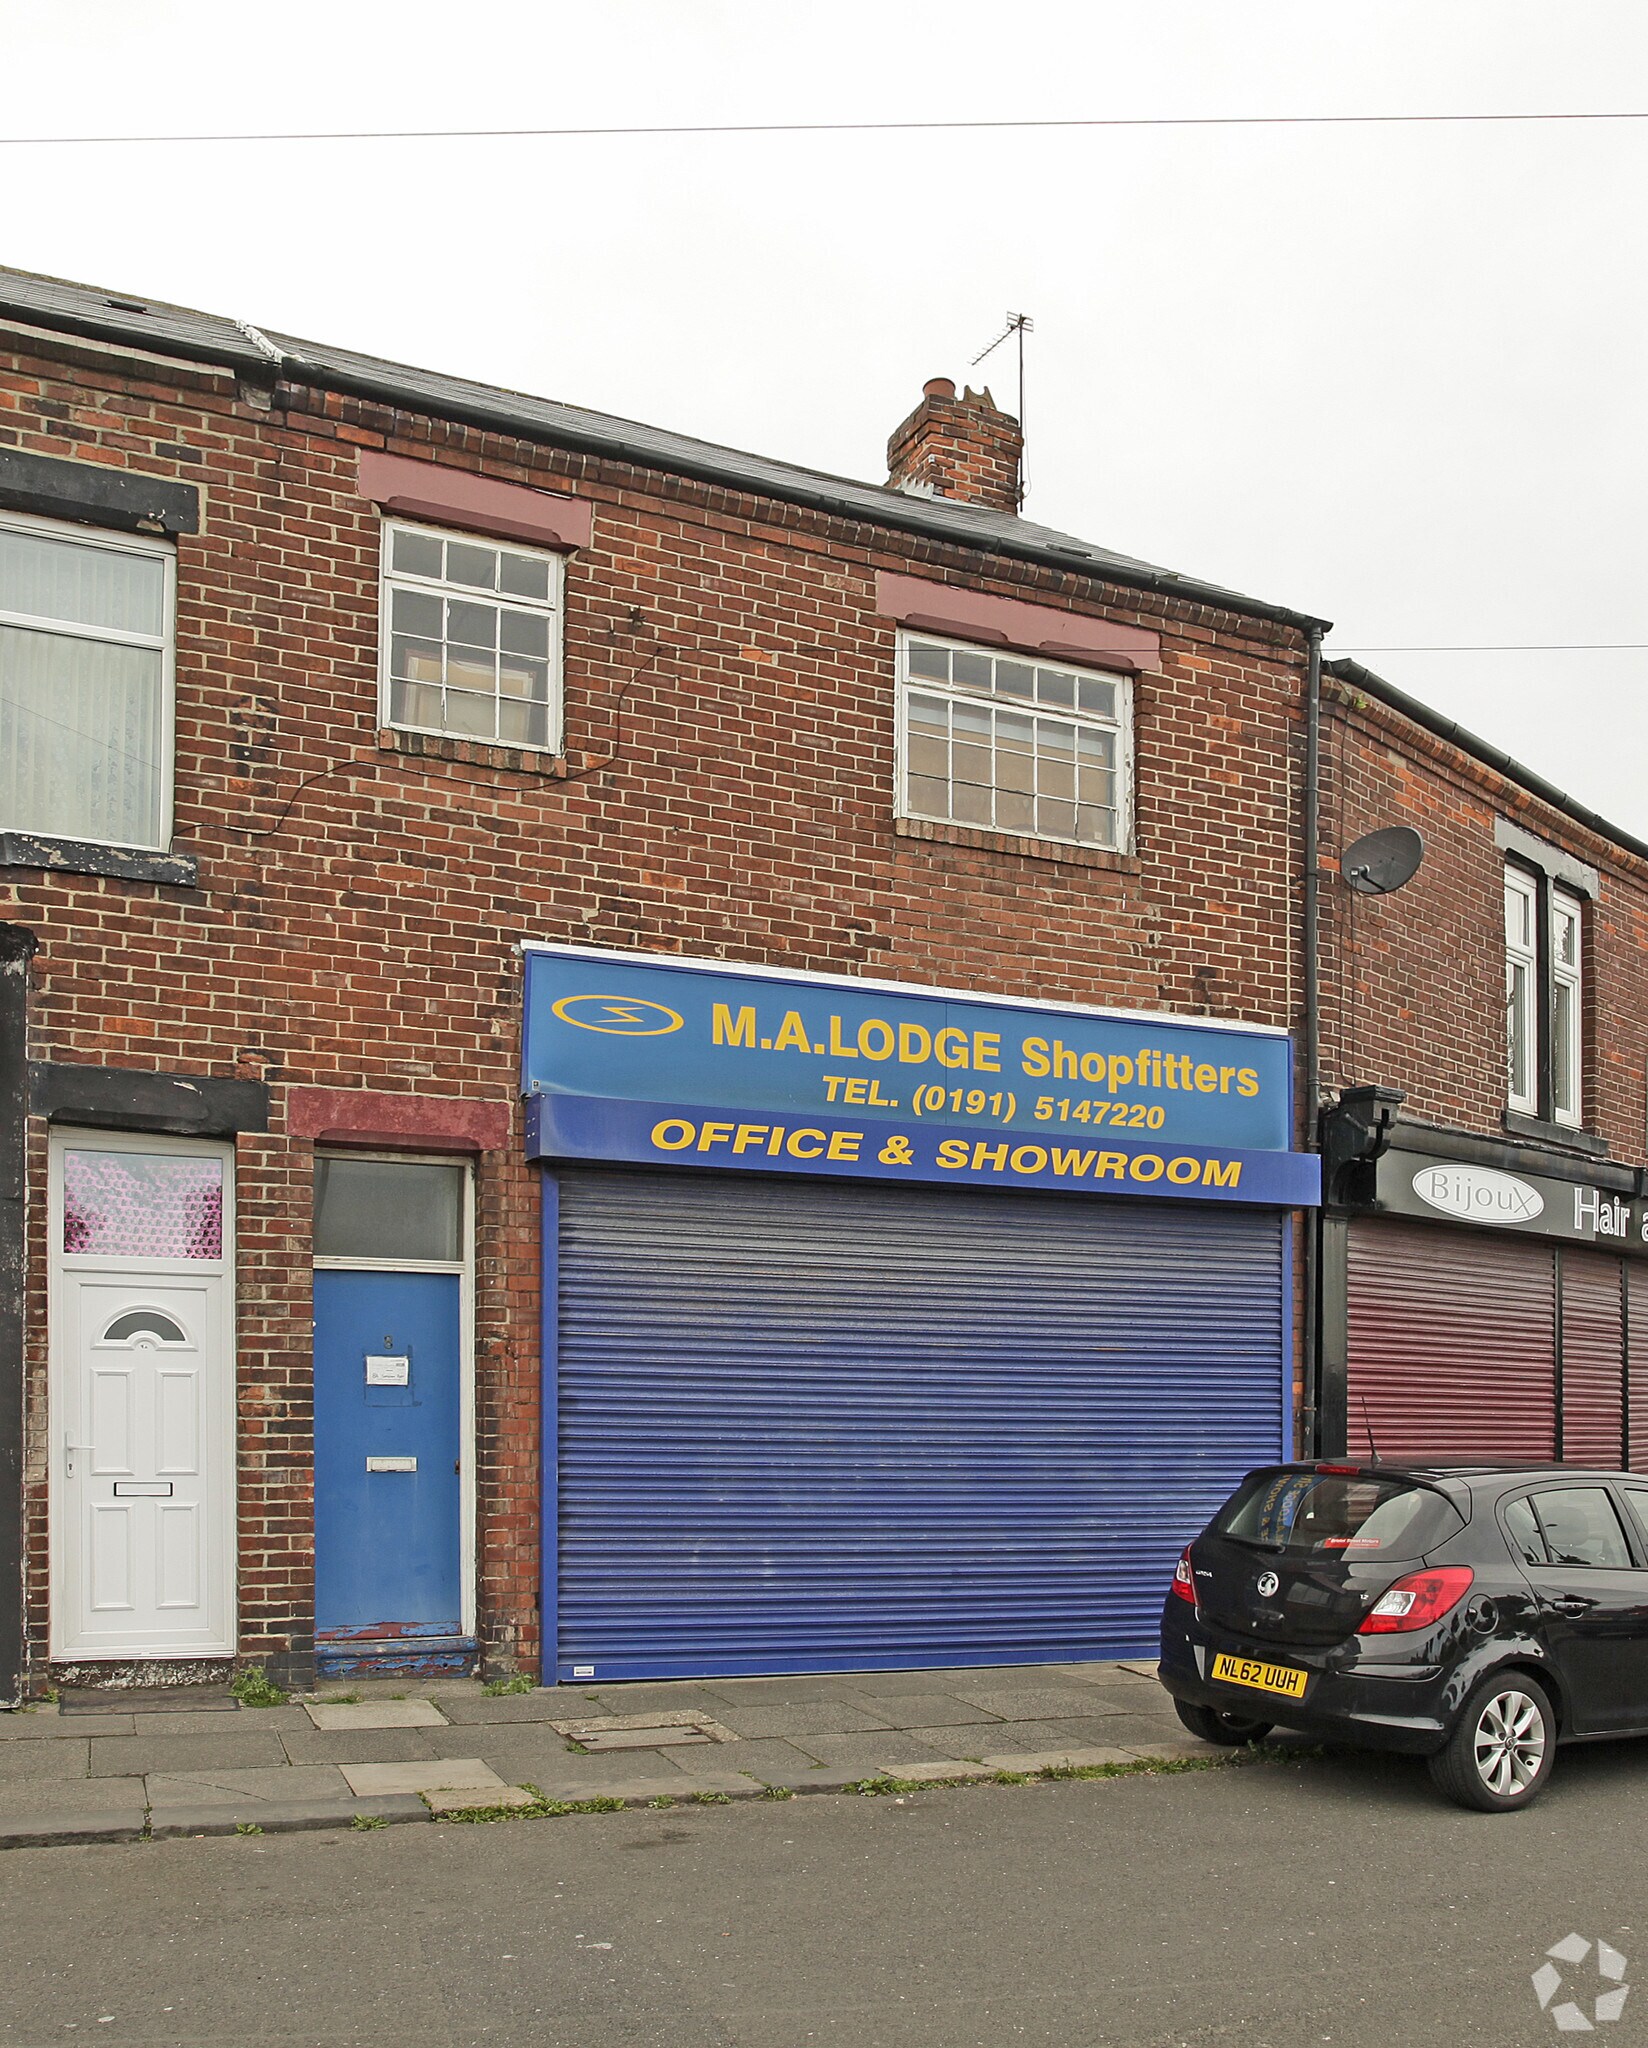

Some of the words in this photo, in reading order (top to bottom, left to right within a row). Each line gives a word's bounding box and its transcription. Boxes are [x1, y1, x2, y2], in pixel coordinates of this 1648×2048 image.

[713, 1003, 1001, 1073] M.A.LODGE
[1021, 1036, 1260, 1097] Shopfitters
[823, 1075, 899, 1107] TEL.
[912, 1084, 1017, 1123] (0191)
[1034, 1096, 1165, 1130] 5147220
[650, 1119, 864, 1161] OFFICE
[877, 1135, 914, 1165] &
[935, 1139, 1243, 1188] SHOWROOM
[1574, 1187, 1630, 1238] Hair
[1219, 1657, 1262, 1683] NL62
[1264, 1666, 1300, 1692] UUH
